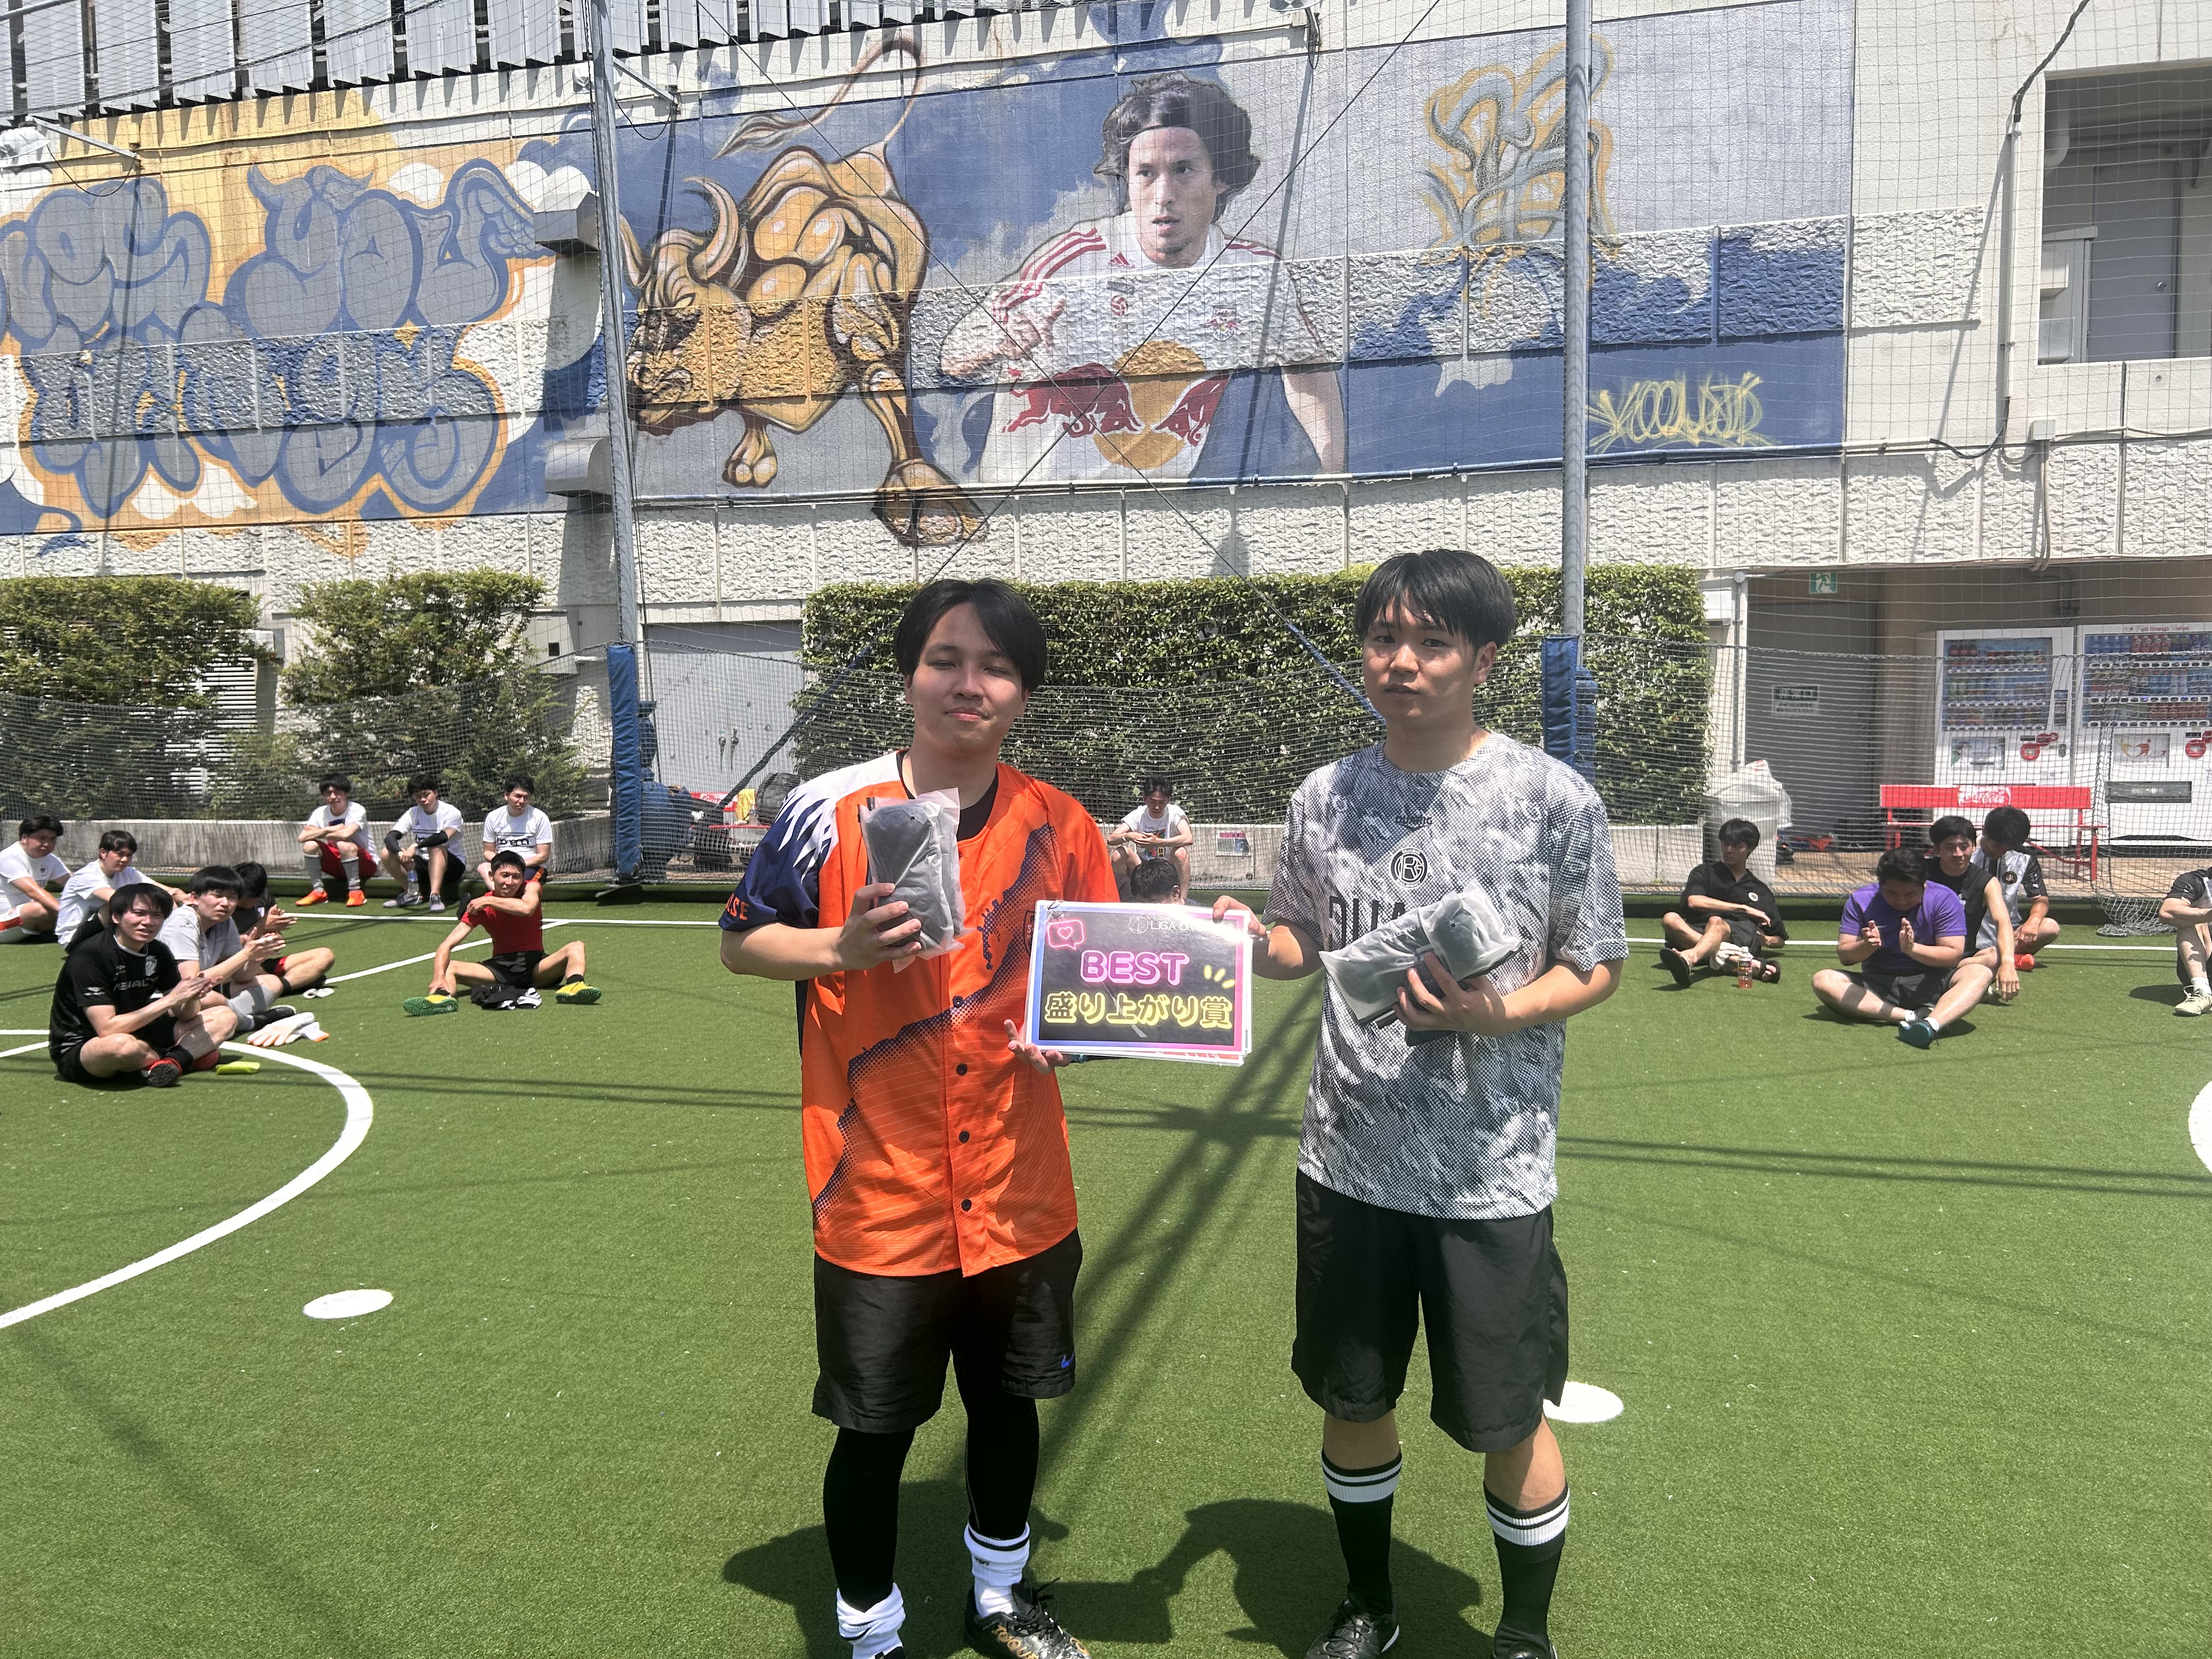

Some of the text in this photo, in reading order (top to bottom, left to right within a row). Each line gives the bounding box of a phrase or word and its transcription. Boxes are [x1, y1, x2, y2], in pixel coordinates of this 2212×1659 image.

[1080, 950, 1190, 985] BEST
[1045, 991, 1233, 1029] 盛り上がり賞
